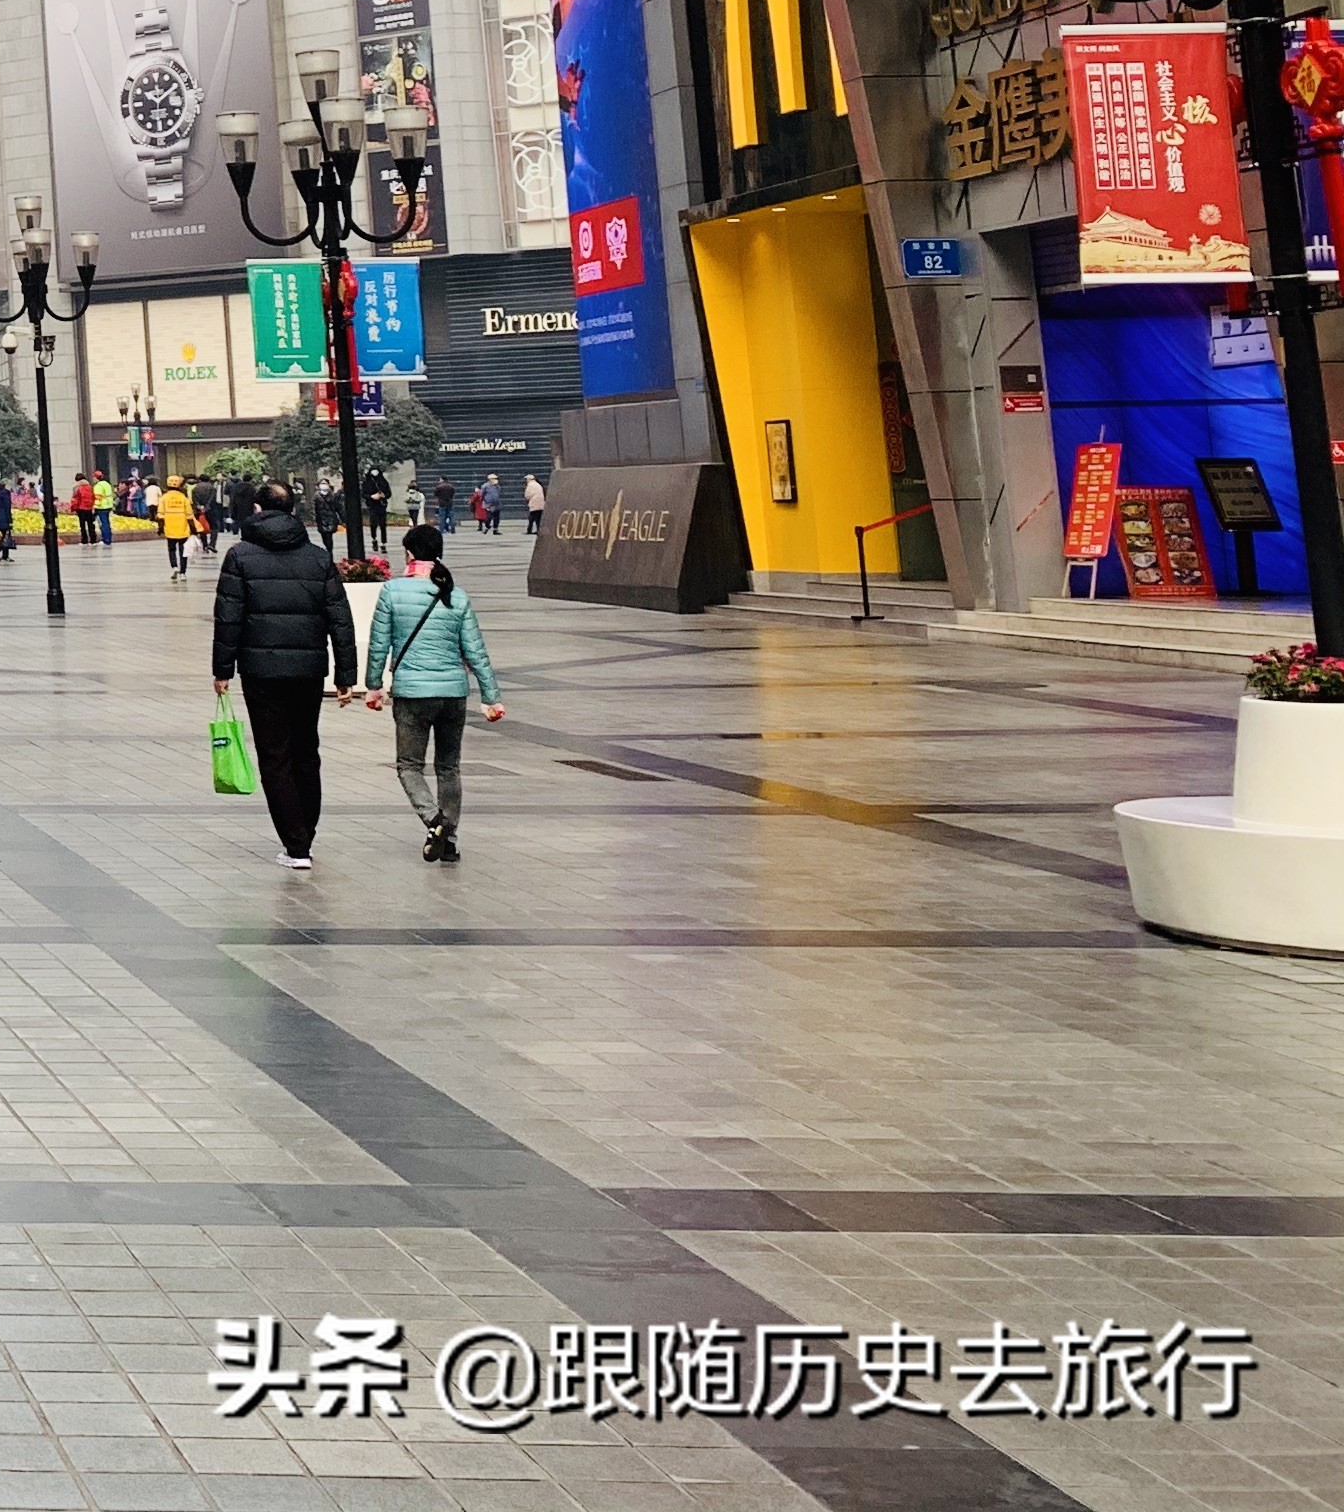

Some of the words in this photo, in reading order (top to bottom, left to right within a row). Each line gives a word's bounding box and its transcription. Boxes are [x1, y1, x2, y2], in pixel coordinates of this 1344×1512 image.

[924, 255, 944, 269] 82
[165, 365, 218, 381] ROLEX
[439, 438, 494, 454] rmenegildo
[556, 509, 611, 541] GOLDEN
[618, 510, 669, 542] EAGLE
